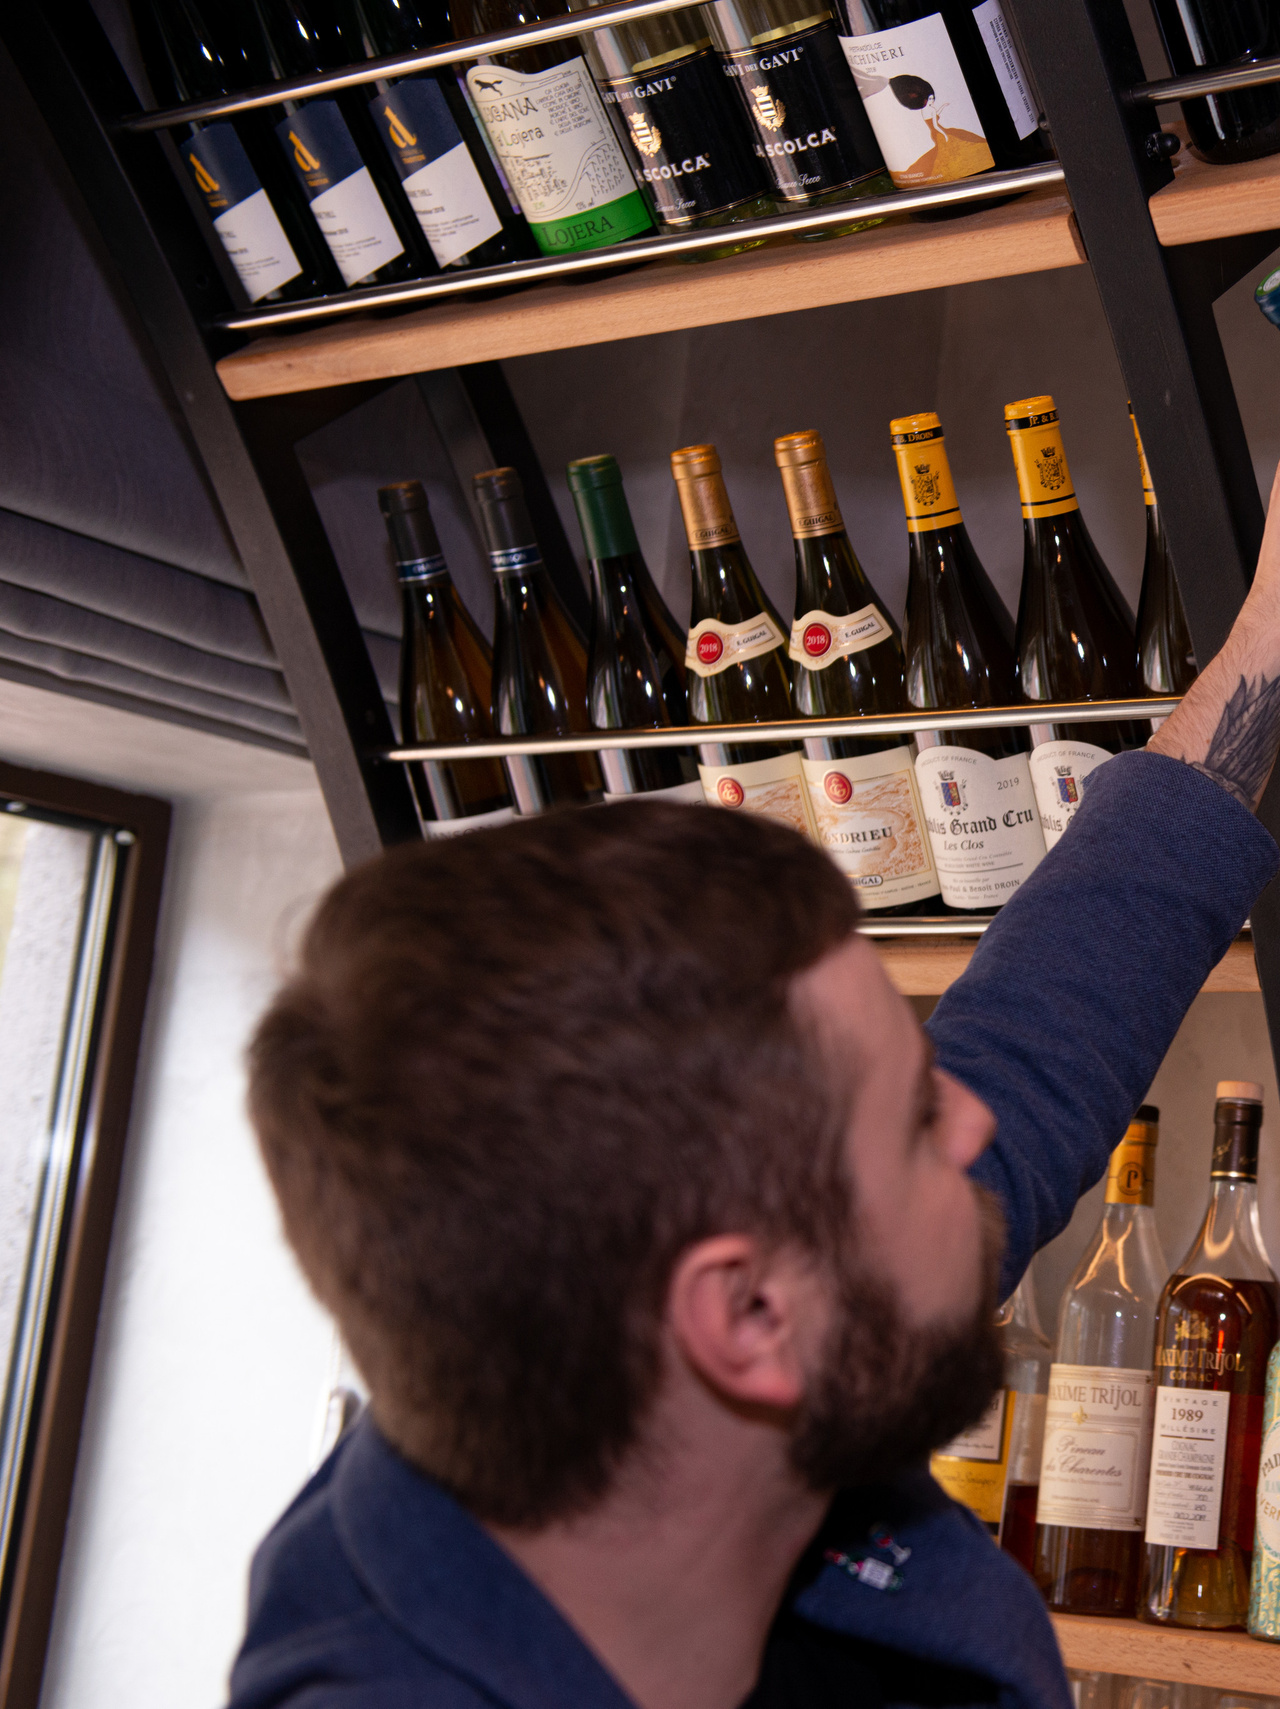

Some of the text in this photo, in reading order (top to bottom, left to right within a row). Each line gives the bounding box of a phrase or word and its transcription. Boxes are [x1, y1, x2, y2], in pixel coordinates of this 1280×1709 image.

[765, 128, 837, 158] SCOLCA
[643, 154, 711, 182] SCOLCA
[541, 215, 615, 247] LOJERA
[806, 634, 826, 646] 2018
[700, 642, 719, 654] 2018
[996, 777, 1020, 791] 2019
[950, 816, 997, 836] Grand
[1002, 809, 1034, 828] Cru
[944, 839, 984, 851] Les Clos
[994, 879, 1020, 890] DROIN
[1163, 1396, 1219, 1407] VINTAGE
[1171, 1408, 1204, 1422] 1989
[1160, 1423, 1217, 1435] MILLÉSIME
